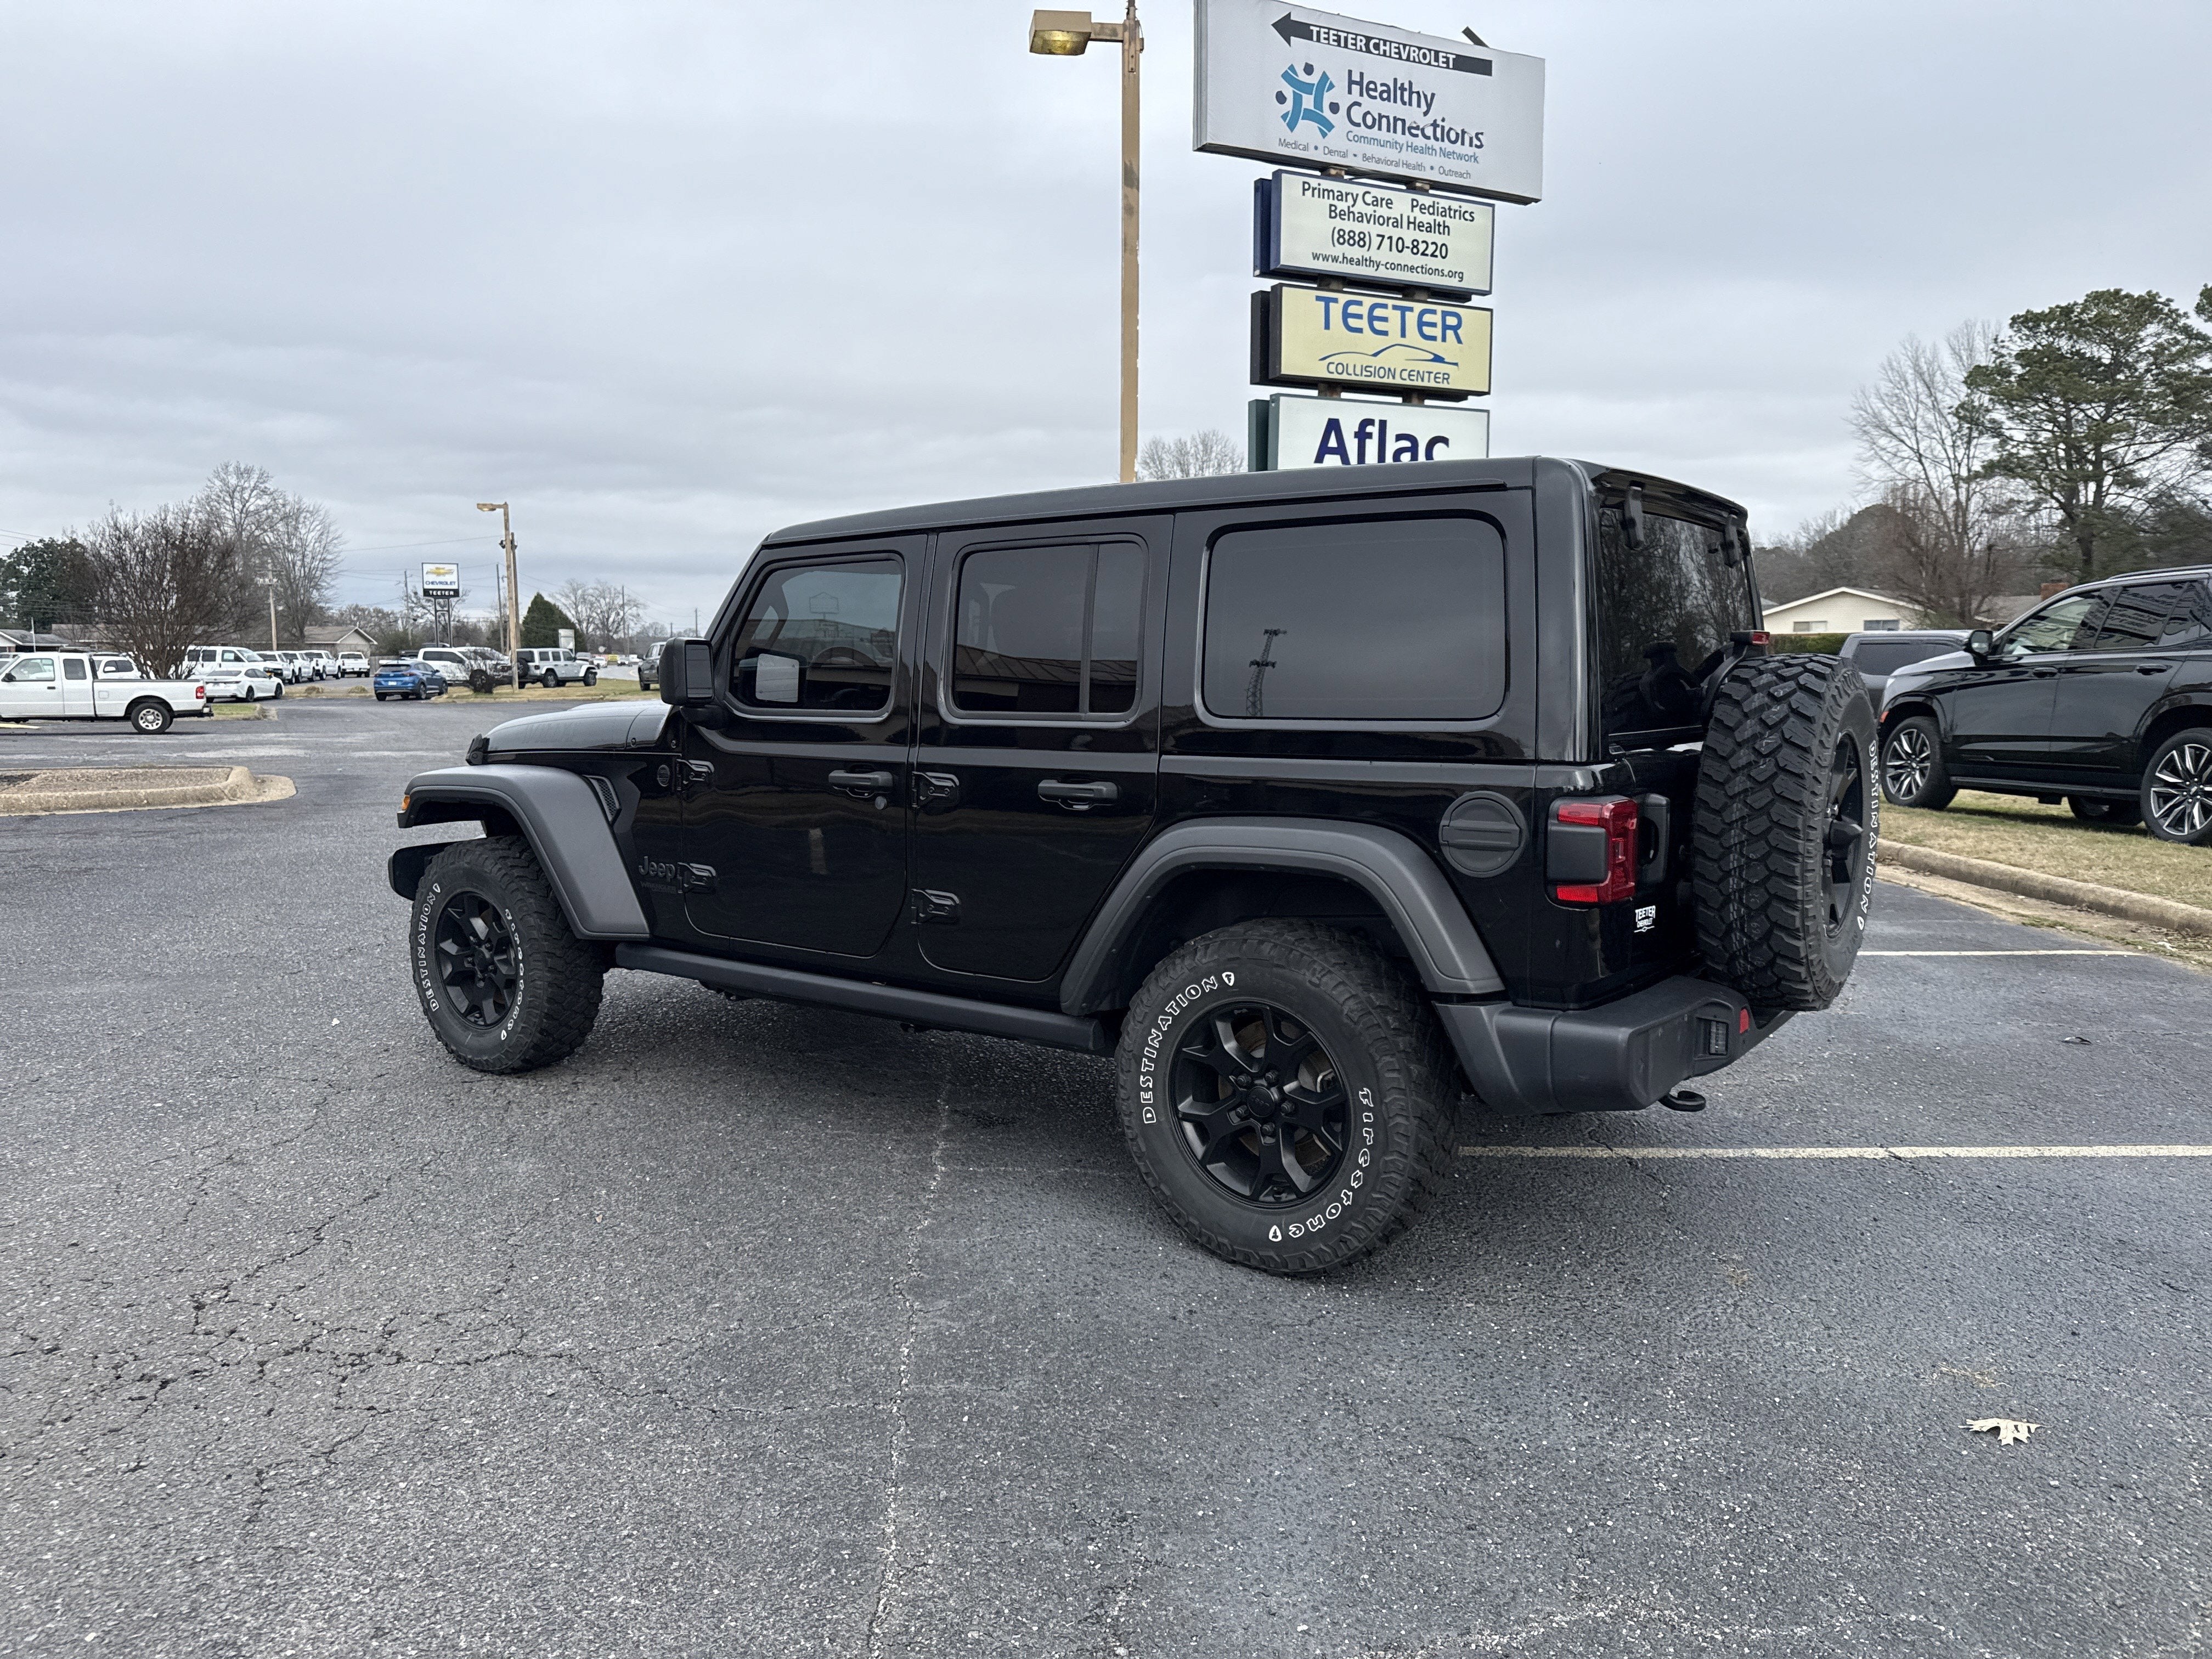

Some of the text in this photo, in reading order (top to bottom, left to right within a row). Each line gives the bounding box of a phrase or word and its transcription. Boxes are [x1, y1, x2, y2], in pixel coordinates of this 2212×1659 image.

[1310, 25, 1456, 69] TEETER CHEVROLET
[1347, 69, 1436, 117] Healthy
[1346, 101, 1485, 149] Connections
[1278, 138, 1471, 179] Medical Dental Behavioral Health Outreach
[1346, 131, 1480, 164] Community Health Network
[1302, 181, 1475, 222] Primary Care Pediatrics
[1329, 204, 1451, 236] Behavioral Health
[1331, 227, 1449, 259] (888) 710-8220
[1312, 252, 1464, 282] www.healthy-connections.org
[1315, 295, 1463, 345] TEETER
[1327, 362, 1451, 385] COLLISION CENTER
[1313, 417, 1449, 466] Aflac
[1860, 740, 1879, 913] DESTINATION
[638, 856, 676, 882] Jeep
[1635, 905, 1656, 922] TEETER
[417, 891, 439, 1012] DESTINATION
[1140, 975, 1218, 1124] DESTINATION
